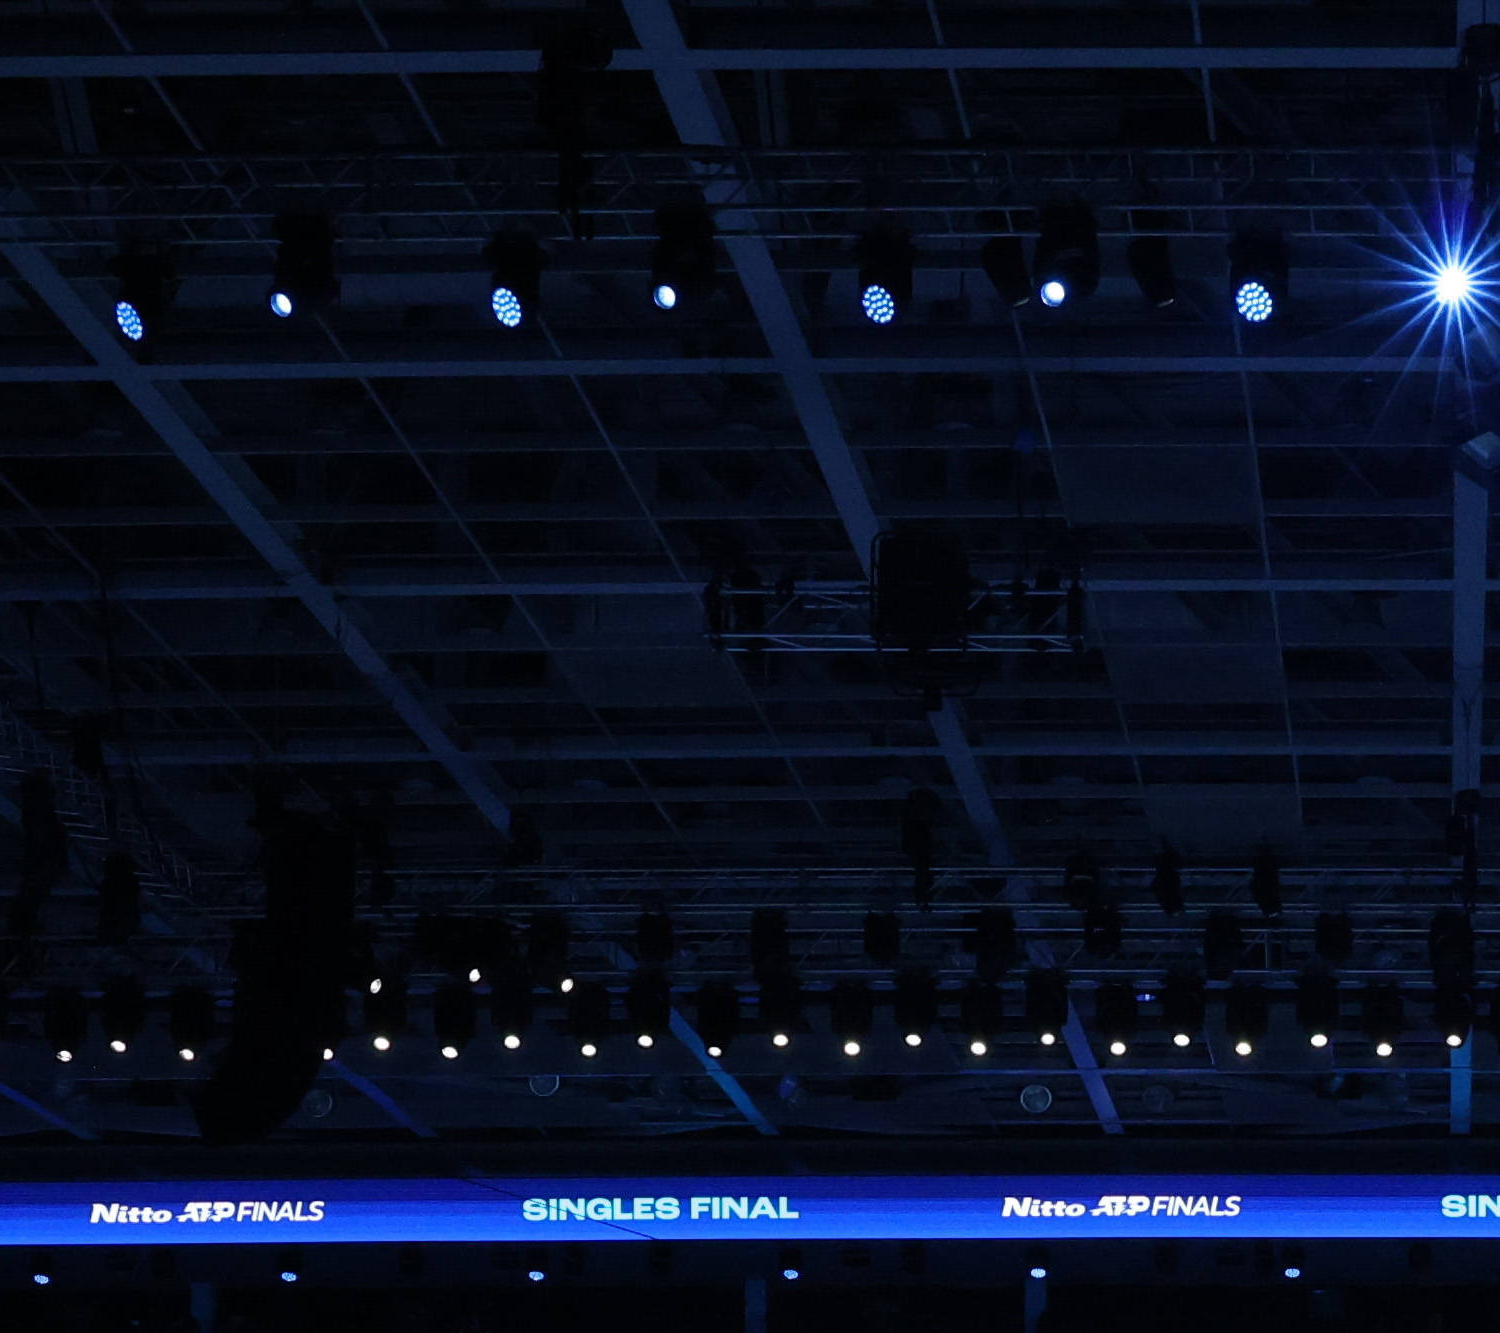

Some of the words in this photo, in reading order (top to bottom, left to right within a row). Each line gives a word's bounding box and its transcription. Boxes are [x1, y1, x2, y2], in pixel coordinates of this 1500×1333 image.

[90, 1203, 173, 1224] Nitto
[176, 1201, 236, 1222] ATP
[237, 1201, 325, 1223] FINALS
[522, 1196, 681, 1221] SINGLES
[690, 1196, 800, 1220] FINAL
[1001, 1196, 1086, 1217] Nitto
[1089, 1196, 1150, 1216] ATP
[1152, 1196, 1242, 1217] FINALS
